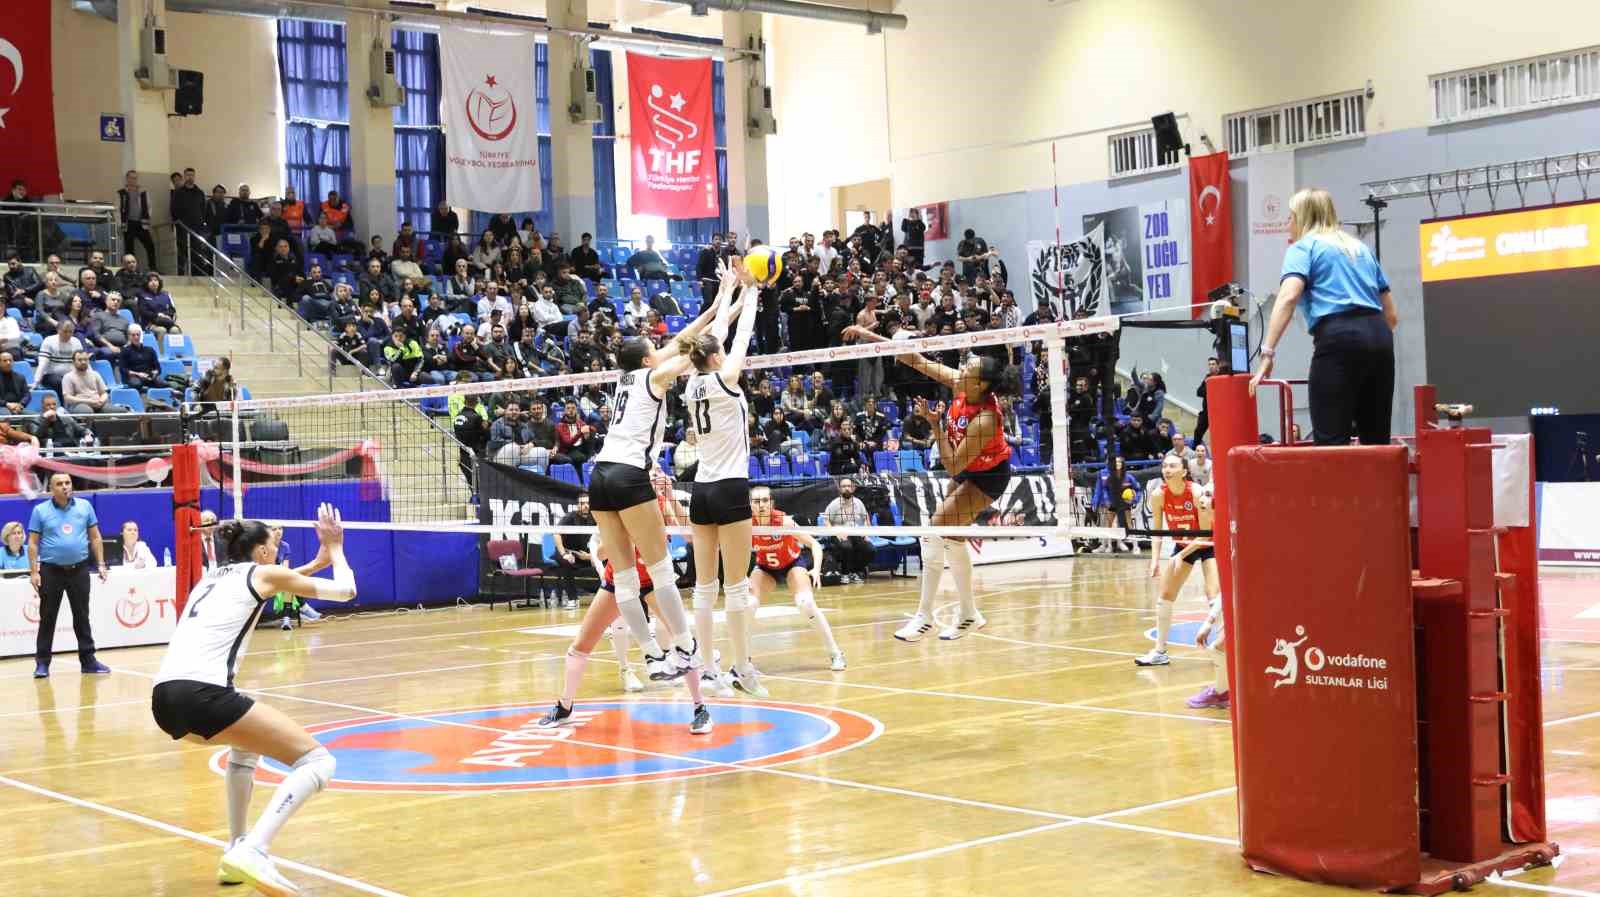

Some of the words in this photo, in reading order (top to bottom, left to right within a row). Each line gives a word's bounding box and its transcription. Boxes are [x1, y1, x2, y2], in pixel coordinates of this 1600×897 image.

[648, 148, 701, 174] THF
[1144, 212, 1168, 239] ZOR
[1147, 272, 1171, 299] YEN
[611, 390, 629, 425] 19
[695, 399, 711, 434] 13
[766, 552, 780, 567] 5
[188, 583, 216, 617] 2
[1327, 654, 1387, 669] vodafone
[1305, 675, 1363, 688] SULTANLAR
[1367, 677, 1388, 689] LİGİ
